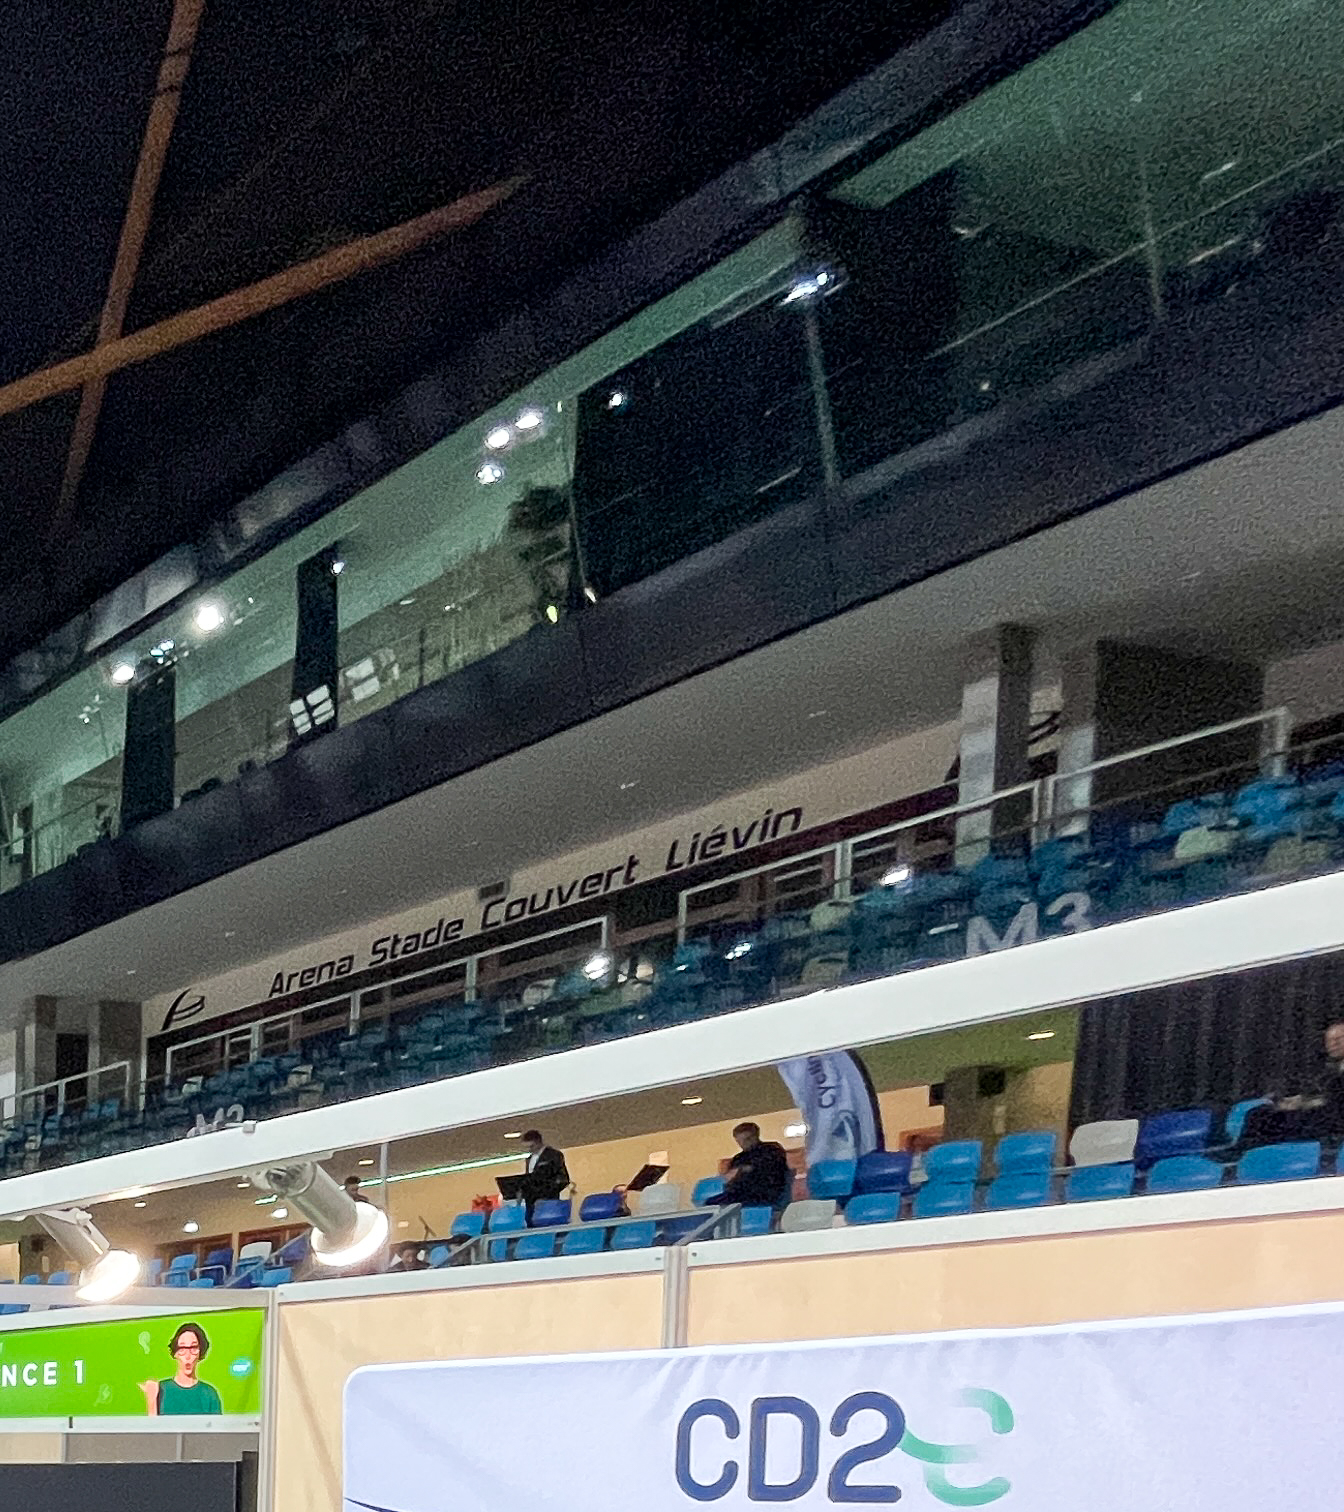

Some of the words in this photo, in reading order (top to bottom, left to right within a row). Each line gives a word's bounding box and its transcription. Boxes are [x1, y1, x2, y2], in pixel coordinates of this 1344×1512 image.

[269, 954, 354, 998] Arena
[369, 917, 465, 965] Stade
[480, 854, 639, 931] Couvert
[666, 805, 804, 870] Liévin
[74, 1359, 86, 1384] 1
